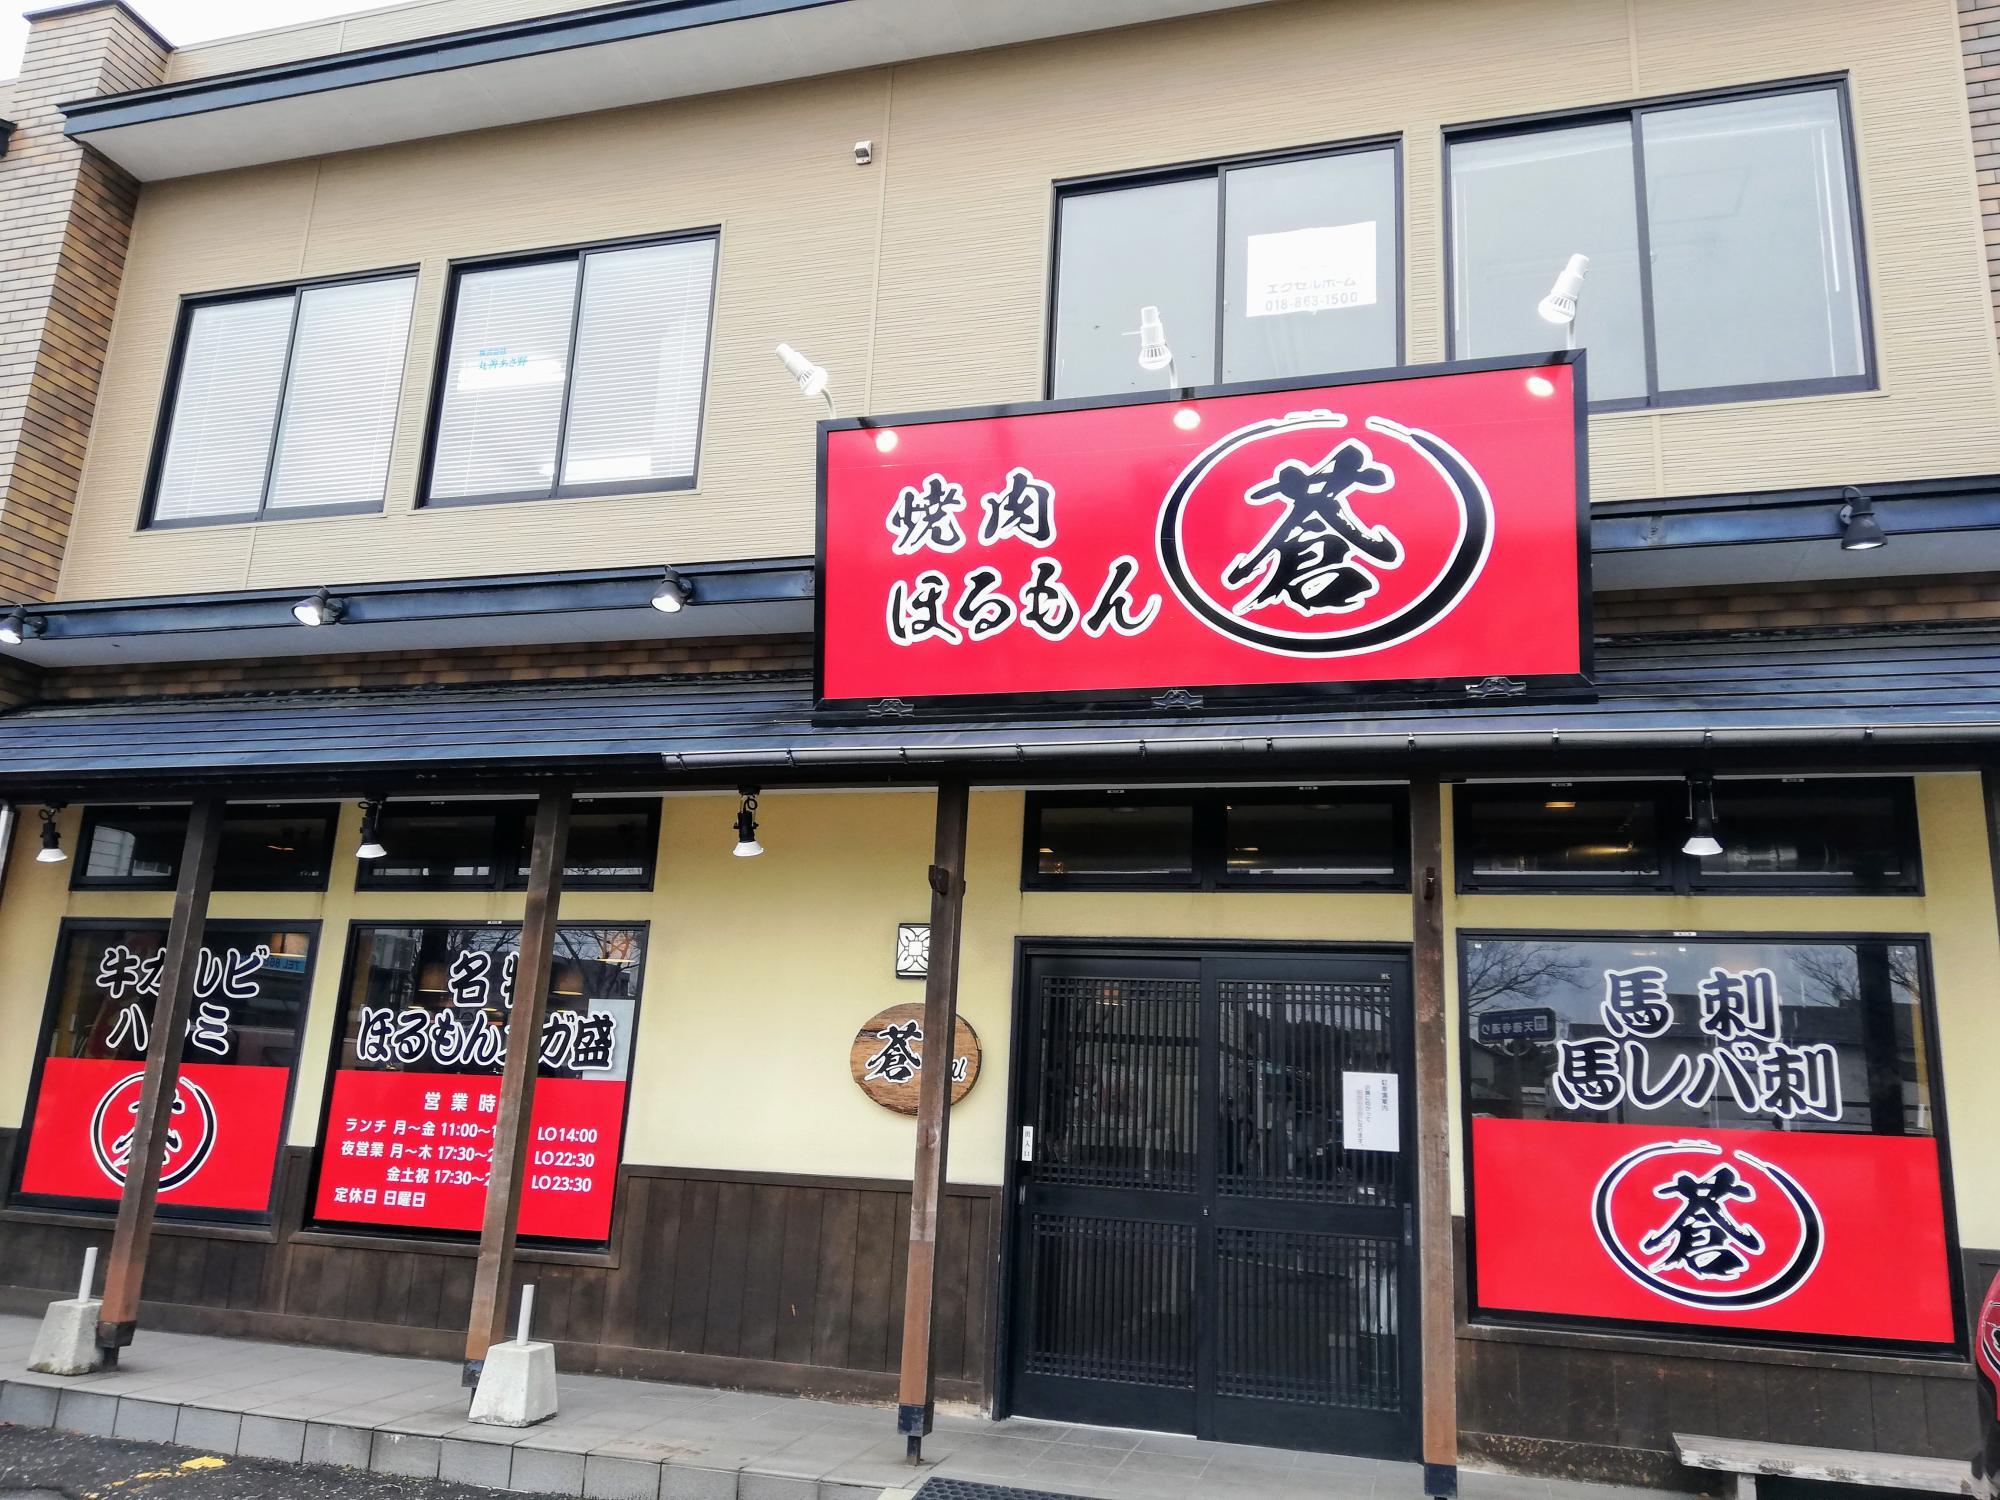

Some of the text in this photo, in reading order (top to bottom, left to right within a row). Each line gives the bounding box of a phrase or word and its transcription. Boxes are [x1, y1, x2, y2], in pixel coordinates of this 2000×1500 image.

[886, 467, 1056, 554] 焼肉
[1221, 438, 1404, 617] 蒼
[886, 555, 1161, 645] ほるもん
[106, 1002, 229, 1055] ハミ
[1600, 966, 1780, 1042] 馬刺
[357, 1007, 616, 1071] ほるもんガ盛
[864, 1019, 923, 1083] 蒼
[424, 1092, 497, 1113] 営業時
[1552, 1037, 1843, 1121] 馬レバ刺
[341, 1140, 385, 1158] 夜営業
[438, 1146, 494, 1163] 17:30～2
[345, 1118, 387, 1133] ランチ
[441, 1122, 497, 1139] 11:00～1
[333, 1187, 427, 1208] 定休日 日曜日
[386, 1166, 429, 1184] 金土祝
[434, 1169, 491, 1187] 17:30～2
[1640, 1163, 1765, 1280] 蒼
